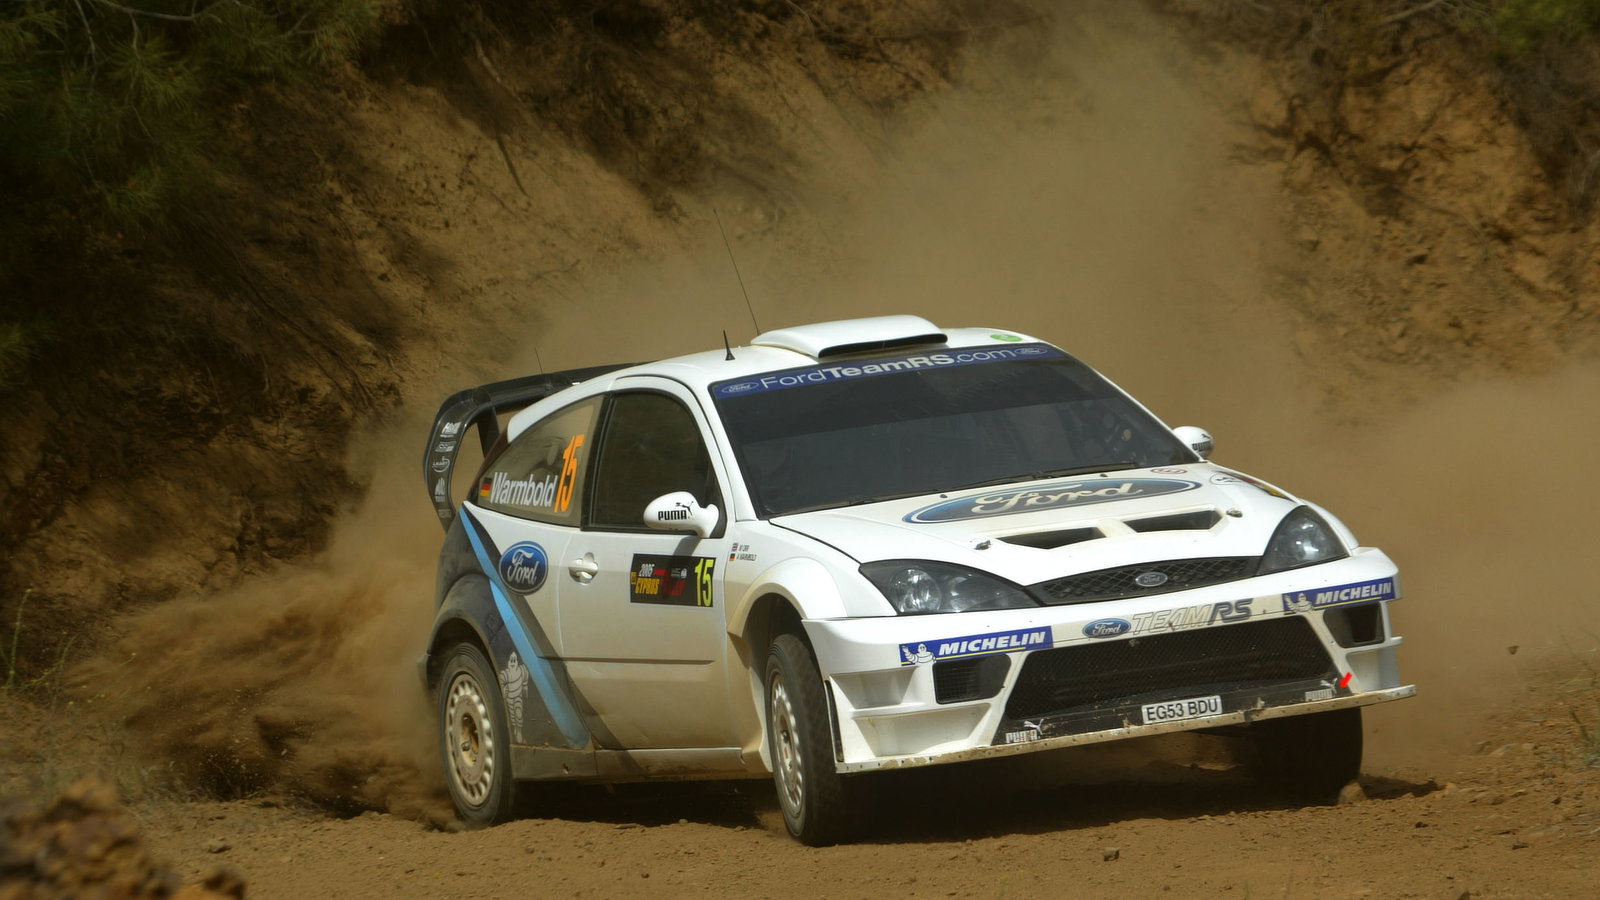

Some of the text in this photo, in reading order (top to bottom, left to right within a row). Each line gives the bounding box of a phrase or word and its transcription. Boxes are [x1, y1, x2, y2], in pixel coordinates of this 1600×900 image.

[760, 349, 1016, 389] FordTeamRS.com
[554, 434, 585, 513] 15
[490, 472, 558, 508] Warmbold
[971, 482, 1143, 514] Ford
[658, 510, 687, 521] PUMA
[507, 549, 538, 587] Ford
[638, 563, 655, 577] 2005
[635, 578, 660, 595] CYPRUS
[694, 557, 714, 607] 15
[1316, 582, 1391, 604] MICHELIN
[1092, 621, 1122, 637] Ford
[938, 631, 1046, 656] MICHELIN
[1146, 698, 1218, 721] EG53 BDU
